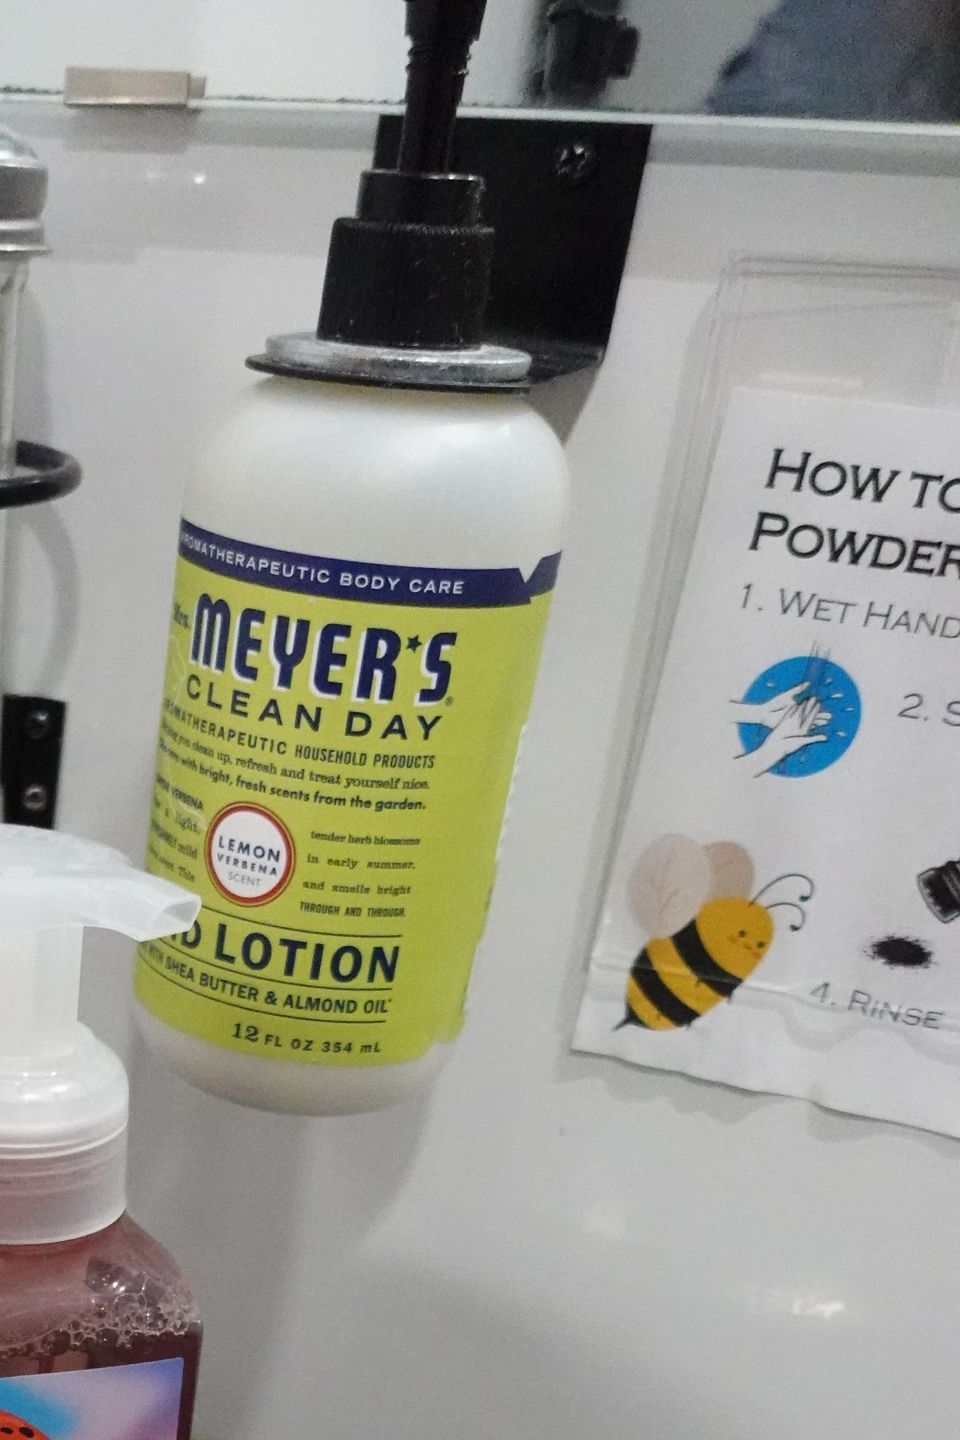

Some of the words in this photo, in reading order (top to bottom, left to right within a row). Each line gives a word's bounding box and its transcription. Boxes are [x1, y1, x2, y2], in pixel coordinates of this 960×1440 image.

[764, 448, 900, 502] HOW
[339, 572, 400, 592] BODY
[408, 578, 466, 595] CARE
[740, 583, 764, 611] 1.
[779, 588, 857, 623] WET
[186, 673, 323, 732] CLEAN
[344, 710, 443, 741] DAY
[897, 693, 929, 723] 2.
[294, 744, 368, 766] HOUSEHOLD
[373, 753, 436, 769] PRODUCTS
[236, 757, 278, 775] refresh
[281, 768, 305, 780] and
[309, 771, 341, 785] treat
[344, 776, 401, 790] yourself
[236, 775, 267, 793] fresh
[270, 786, 310, 802] scents
[313, 791, 346, 806] from
[350, 795, 372, 809] the
[374, 798, 426, 813] garden.
[218, 836, 281, 863] LEMON
[310, 831, 346, 843] tender
[348, 834, 372, 845] herb
[217, 853, 278, 876] VERBENA
[307, 853, 319, 864] in
[327, 858, 358, 870] early
[227, 871, 261, 887] SCENT
[303, 881, 325, 891] and
[332, 884, 371, 895] smells
[377, 885, 411, 896] bright
[300, 901, 340, 915] THROUGH
[344, 907, 362, 917] AND
[215, 923, 400, 984] LOTION
[166, 955, 195, 982] SHEA
[199, 972, 259, 1002] BUTTER
[264, 990, 278, 1006] &
[283, 994, 358, 1015] ALMOND
[809, 982, 836, 1006] 4.
[847, 989, 945, 1030] RINSE
[232, 1023, 260, 1043] 12
[264, 1034, 282, 1047] FL
[291, 1038, 314, 1051] OZ
[321, 1041, 353, 1053] 354
[360, 1043, 382, 1053] mL
